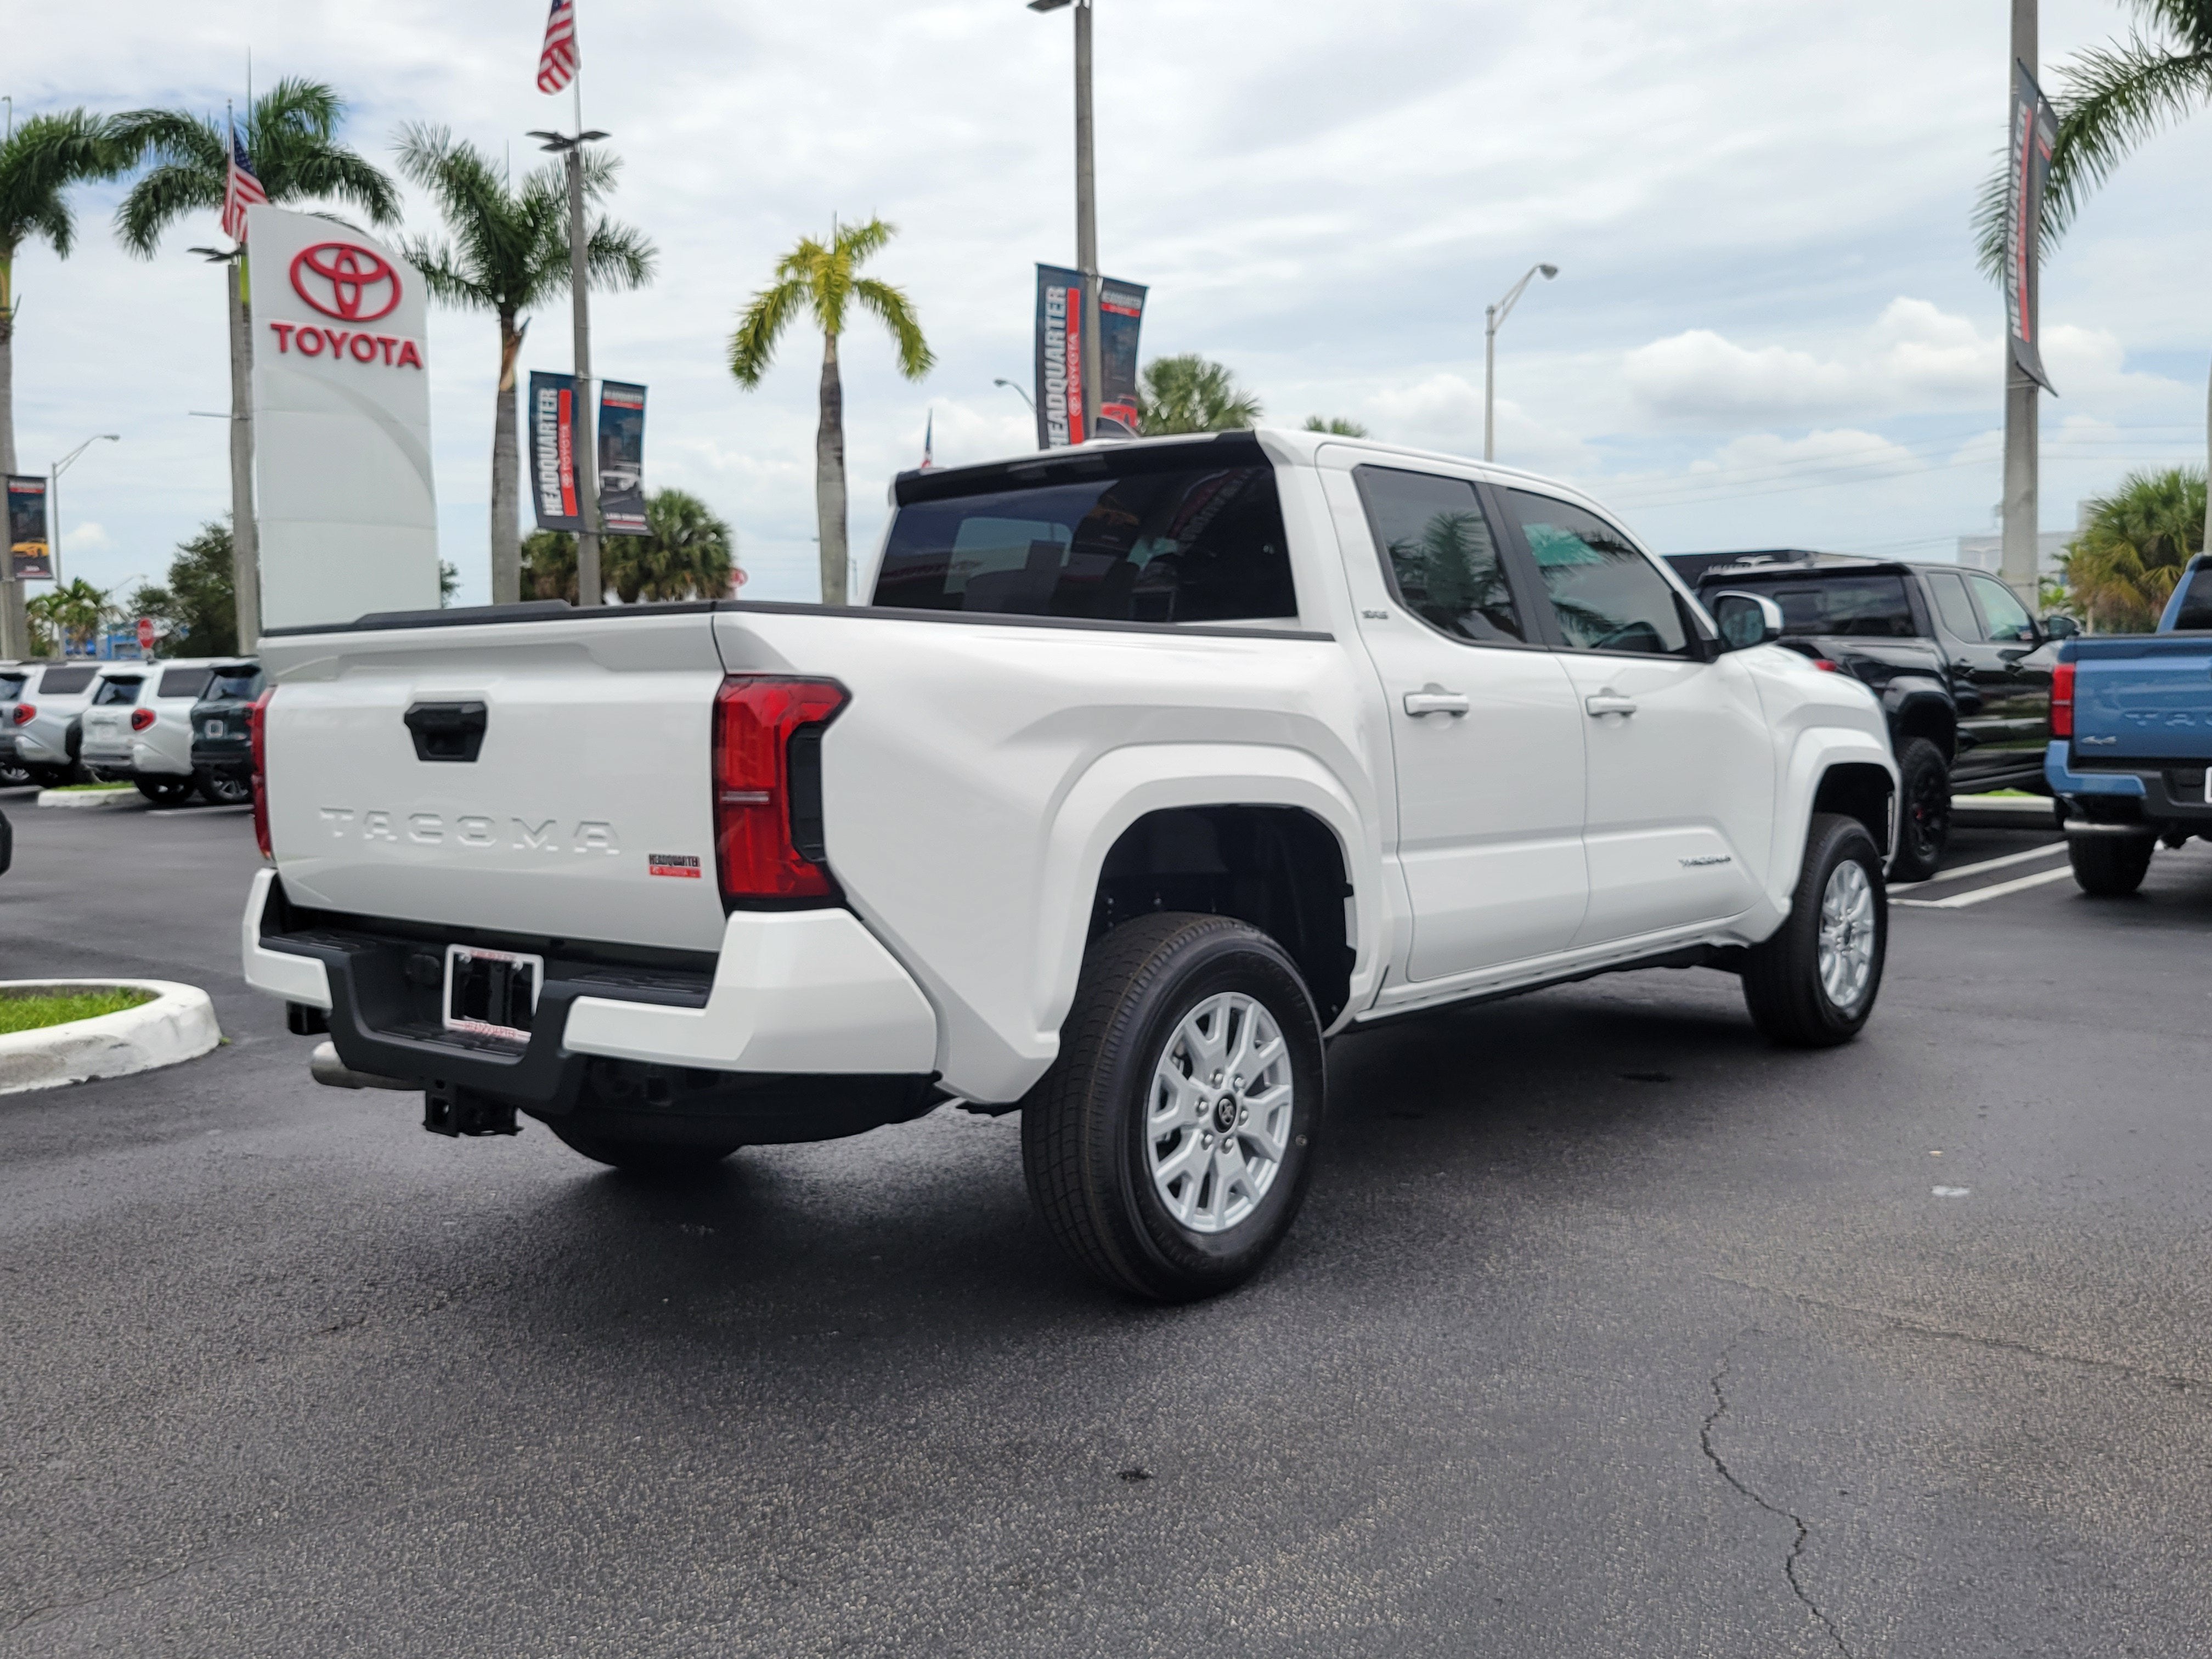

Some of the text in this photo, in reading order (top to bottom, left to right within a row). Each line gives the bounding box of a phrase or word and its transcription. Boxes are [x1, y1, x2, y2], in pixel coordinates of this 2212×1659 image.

[2007, 100, 2027, 339] HEADQUARTER
[270, 322, 422, 369] TOYOTA
[1068, 332, 1080, 393] TOYOTA
[537, 388, 564, 516] HEADQUARTER
[320, 808, 620, 855] TACOMA
